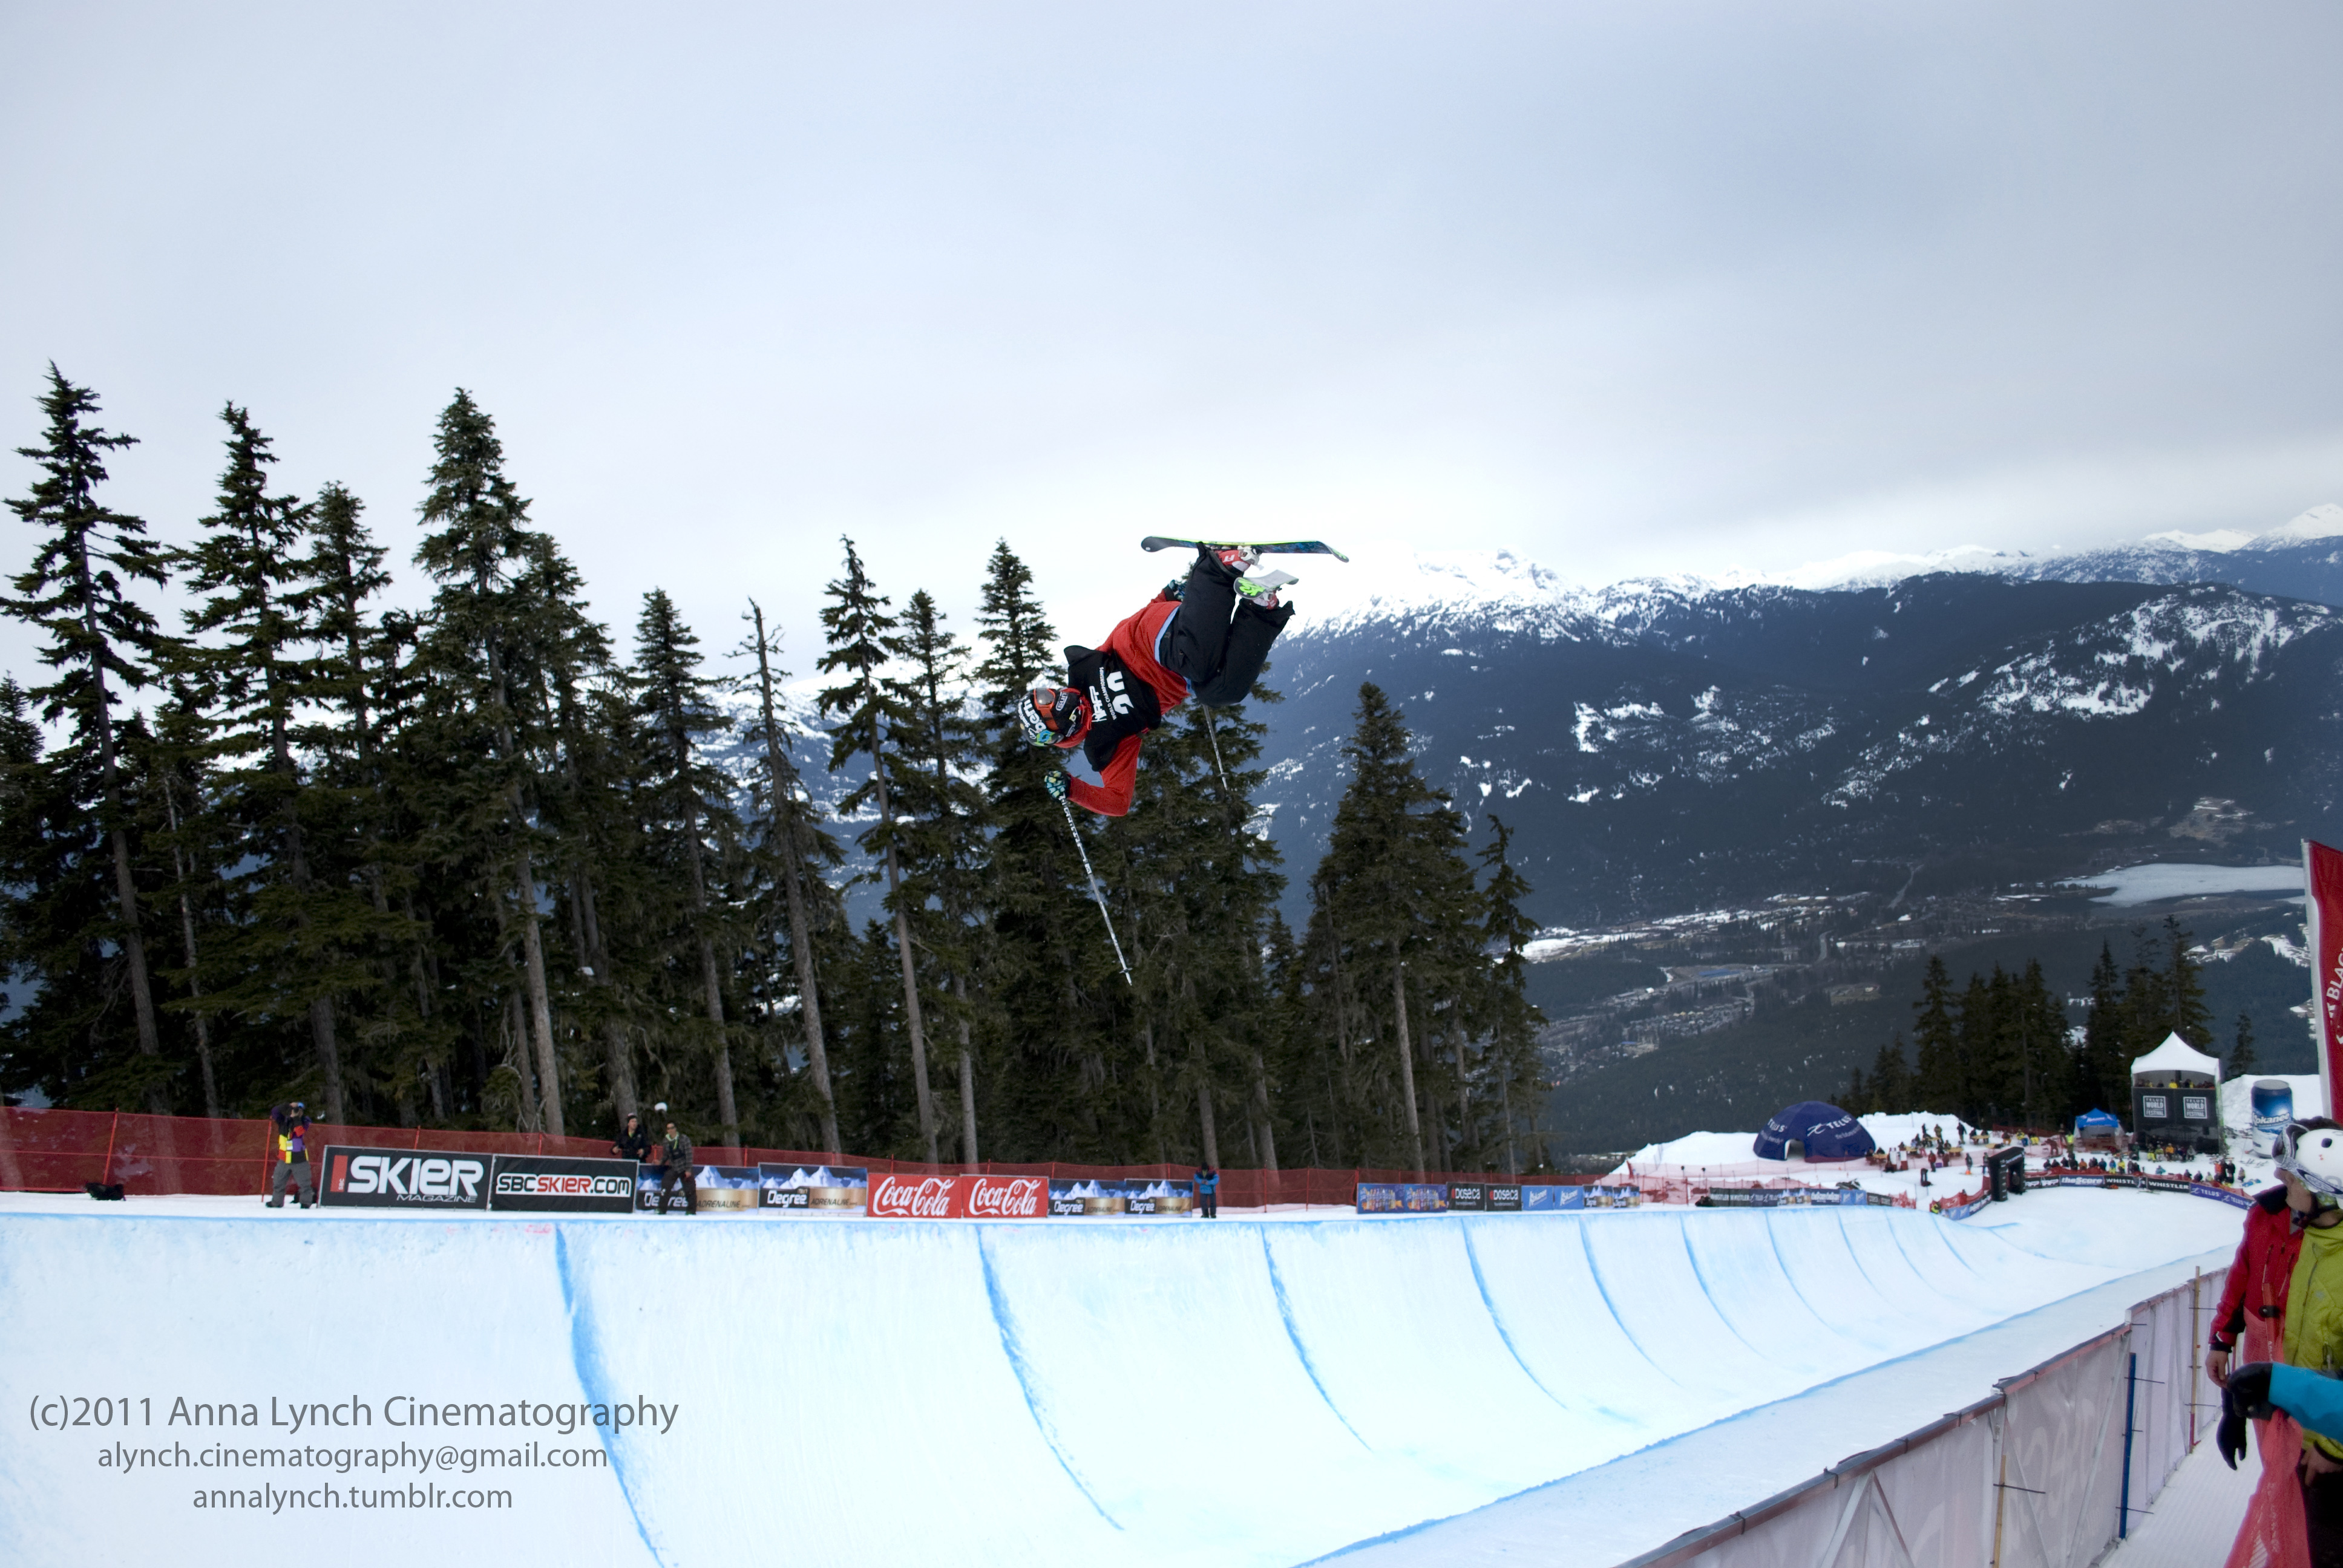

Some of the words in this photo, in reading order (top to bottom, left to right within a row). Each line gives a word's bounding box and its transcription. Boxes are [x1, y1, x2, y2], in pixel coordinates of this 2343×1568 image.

[1107, 703, 1117, 720] WORLD
[1826, 1114, 1852, 1129] TELUS
[2148, 1181, 2189, 1189] WHISTLER
[396, 1194, 478, 1203] MAGAZINE
[644, 1191, 689, 1207] Deree
[767, 1190, 808, 1207] Degree
[873, 1175, 956, 1217] Coca-Cola
[969, 1178, 1041, 1216] Coca-Cola
[2201, 1189, 2220, 1197] TELUS
[1054, 1200, 1084, 1215] Degree
[1130, 1200, 1155, 1214] Degree
